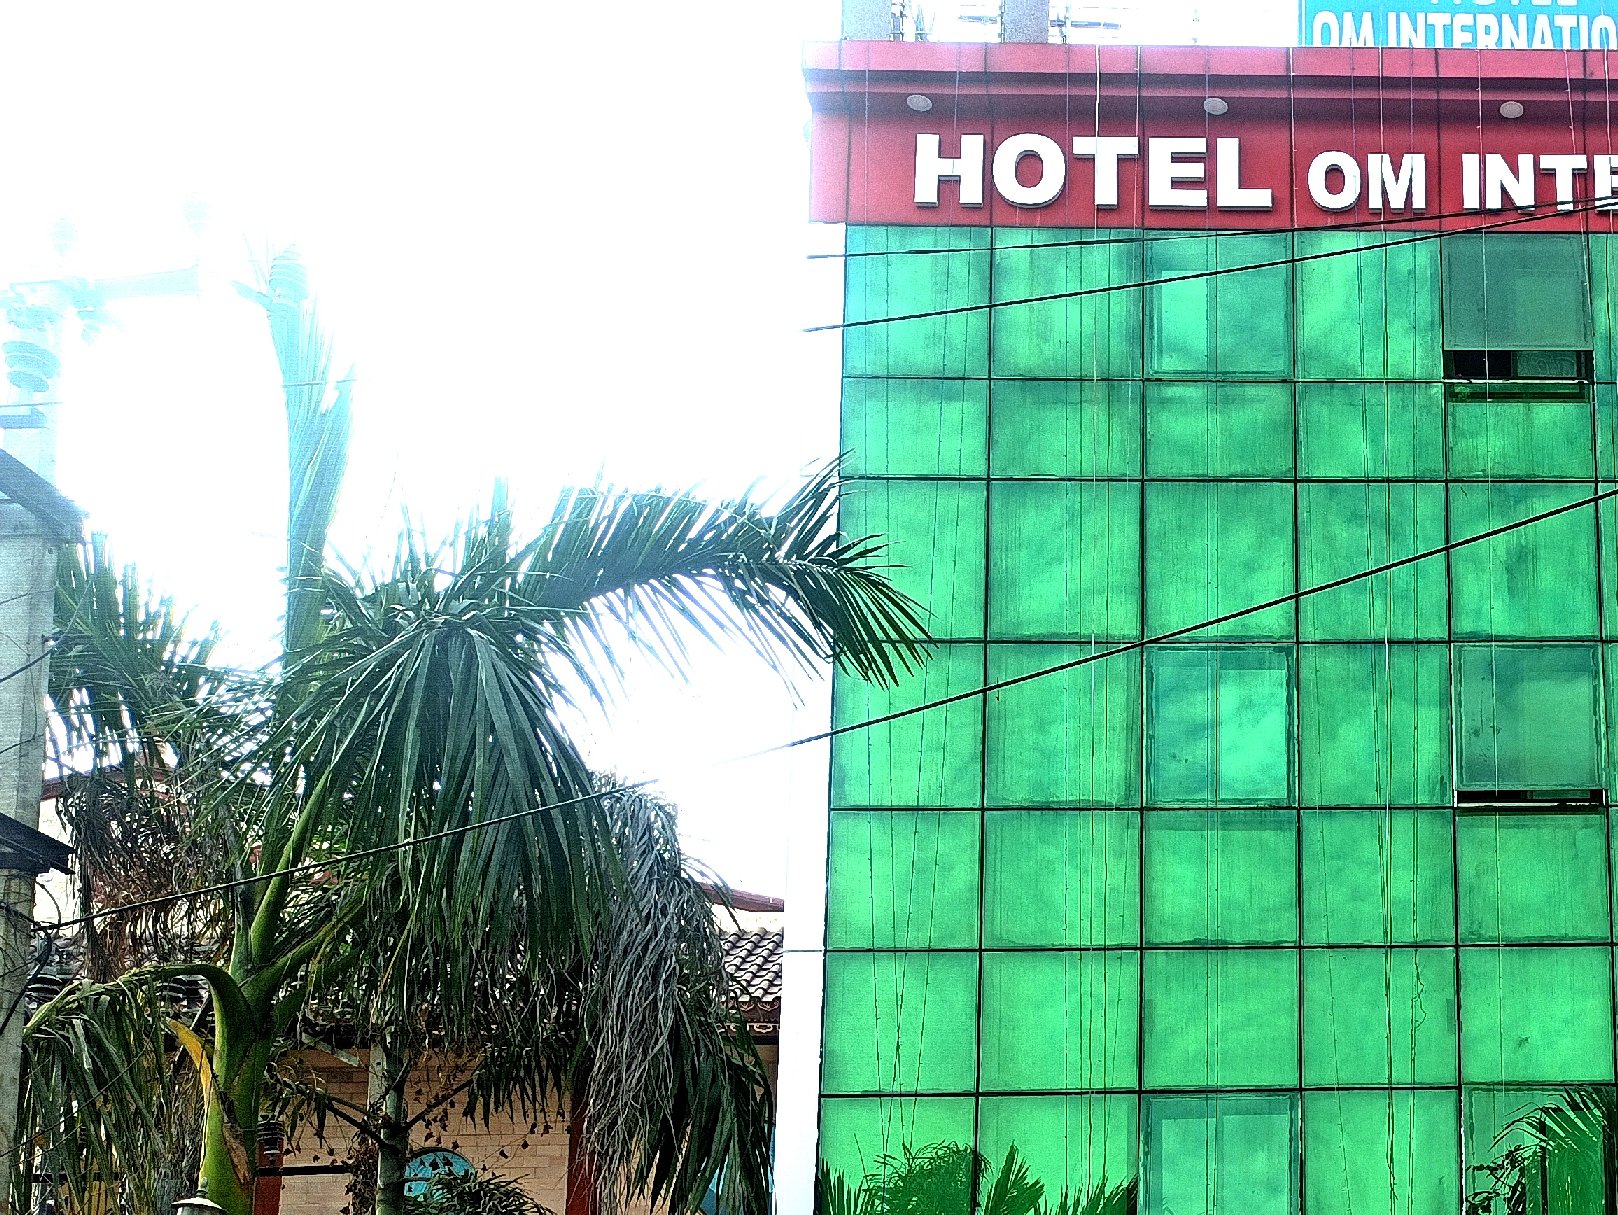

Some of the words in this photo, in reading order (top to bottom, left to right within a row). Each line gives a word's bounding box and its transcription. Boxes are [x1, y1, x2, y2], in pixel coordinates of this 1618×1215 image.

[1312, 11, 1374, 48] OM
[914, 132, 1273, 210] HOTEL
[1307, 150, 1427, 214] OM
